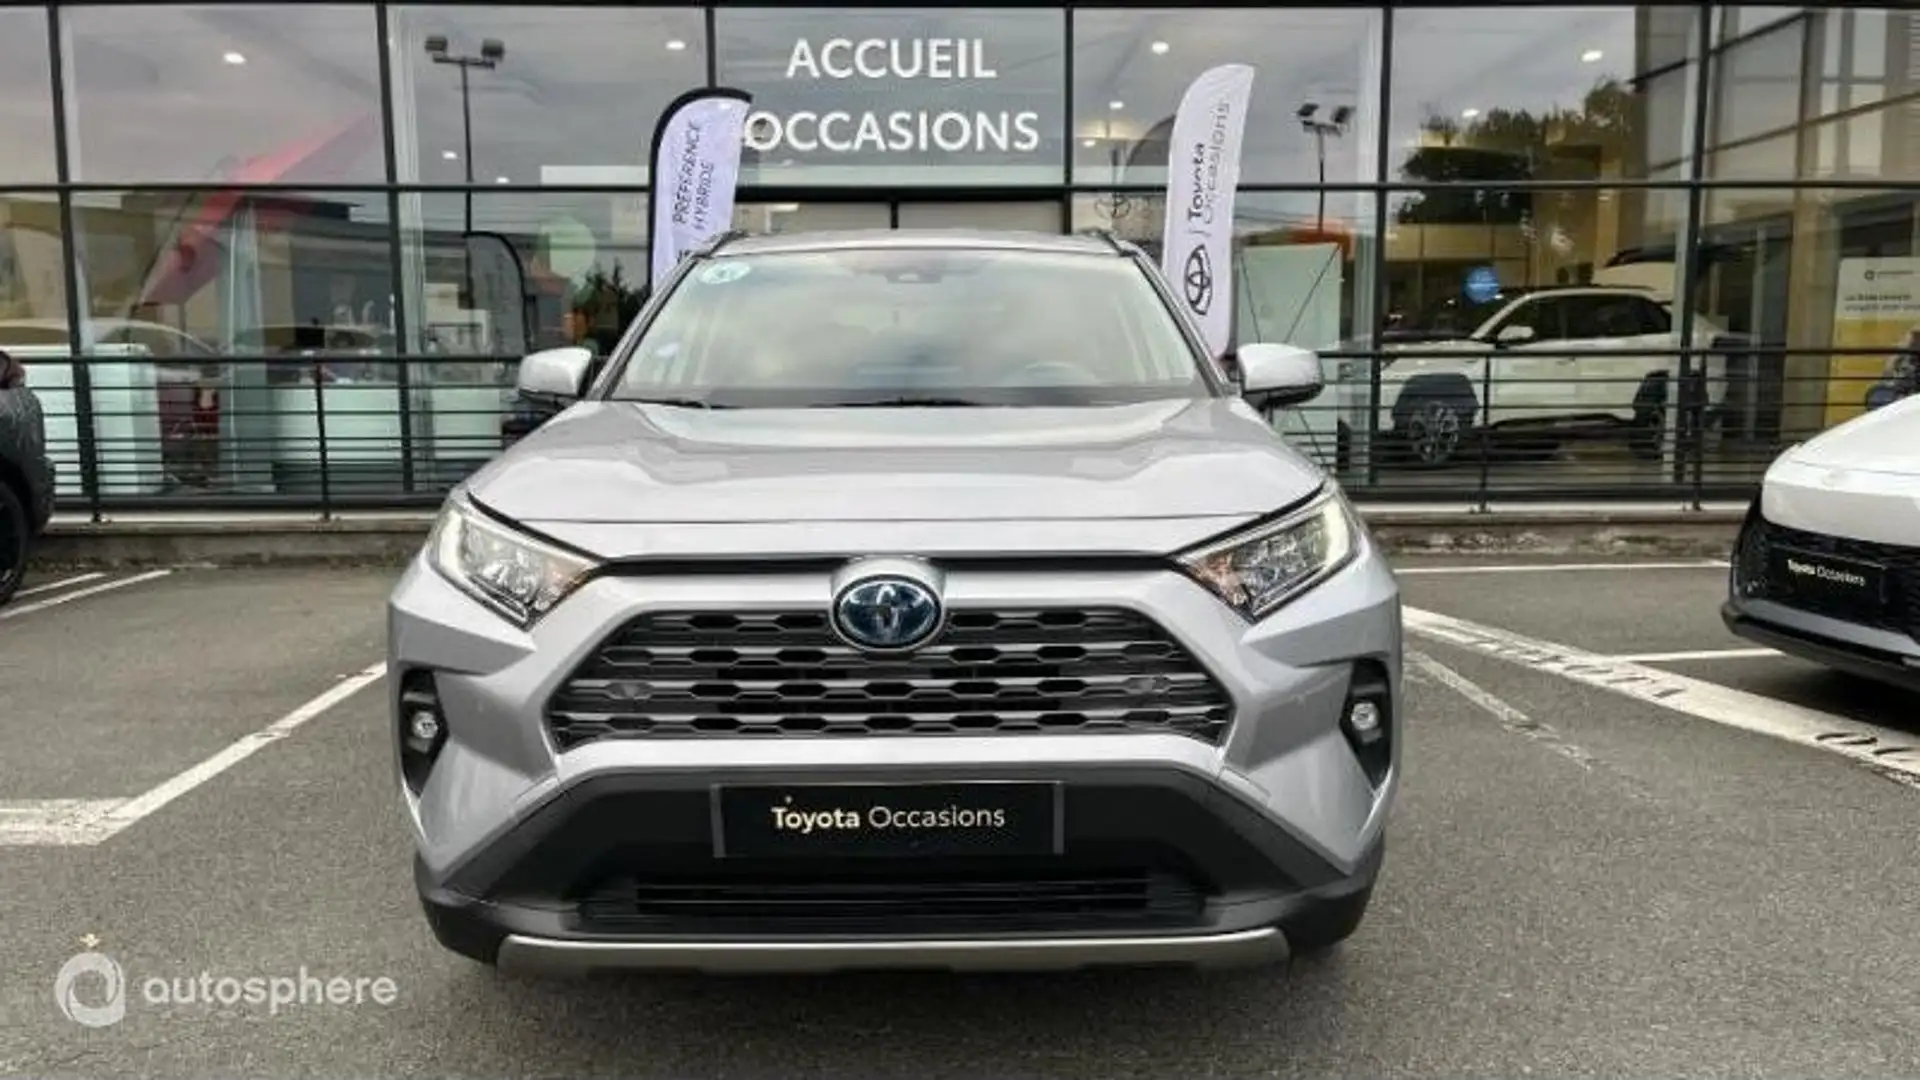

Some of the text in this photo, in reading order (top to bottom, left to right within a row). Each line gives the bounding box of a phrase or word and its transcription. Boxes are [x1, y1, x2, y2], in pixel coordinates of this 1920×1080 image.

[785, 38, 998, 79] ACCUEIL
[744, 110, 1040, 151] OCCASIONS
[1187, 142, 1205, 221] Toyota
[1203, 101, 1231, 225] Occasions
[771, 804, 1006, 834] Toyota Occasions
